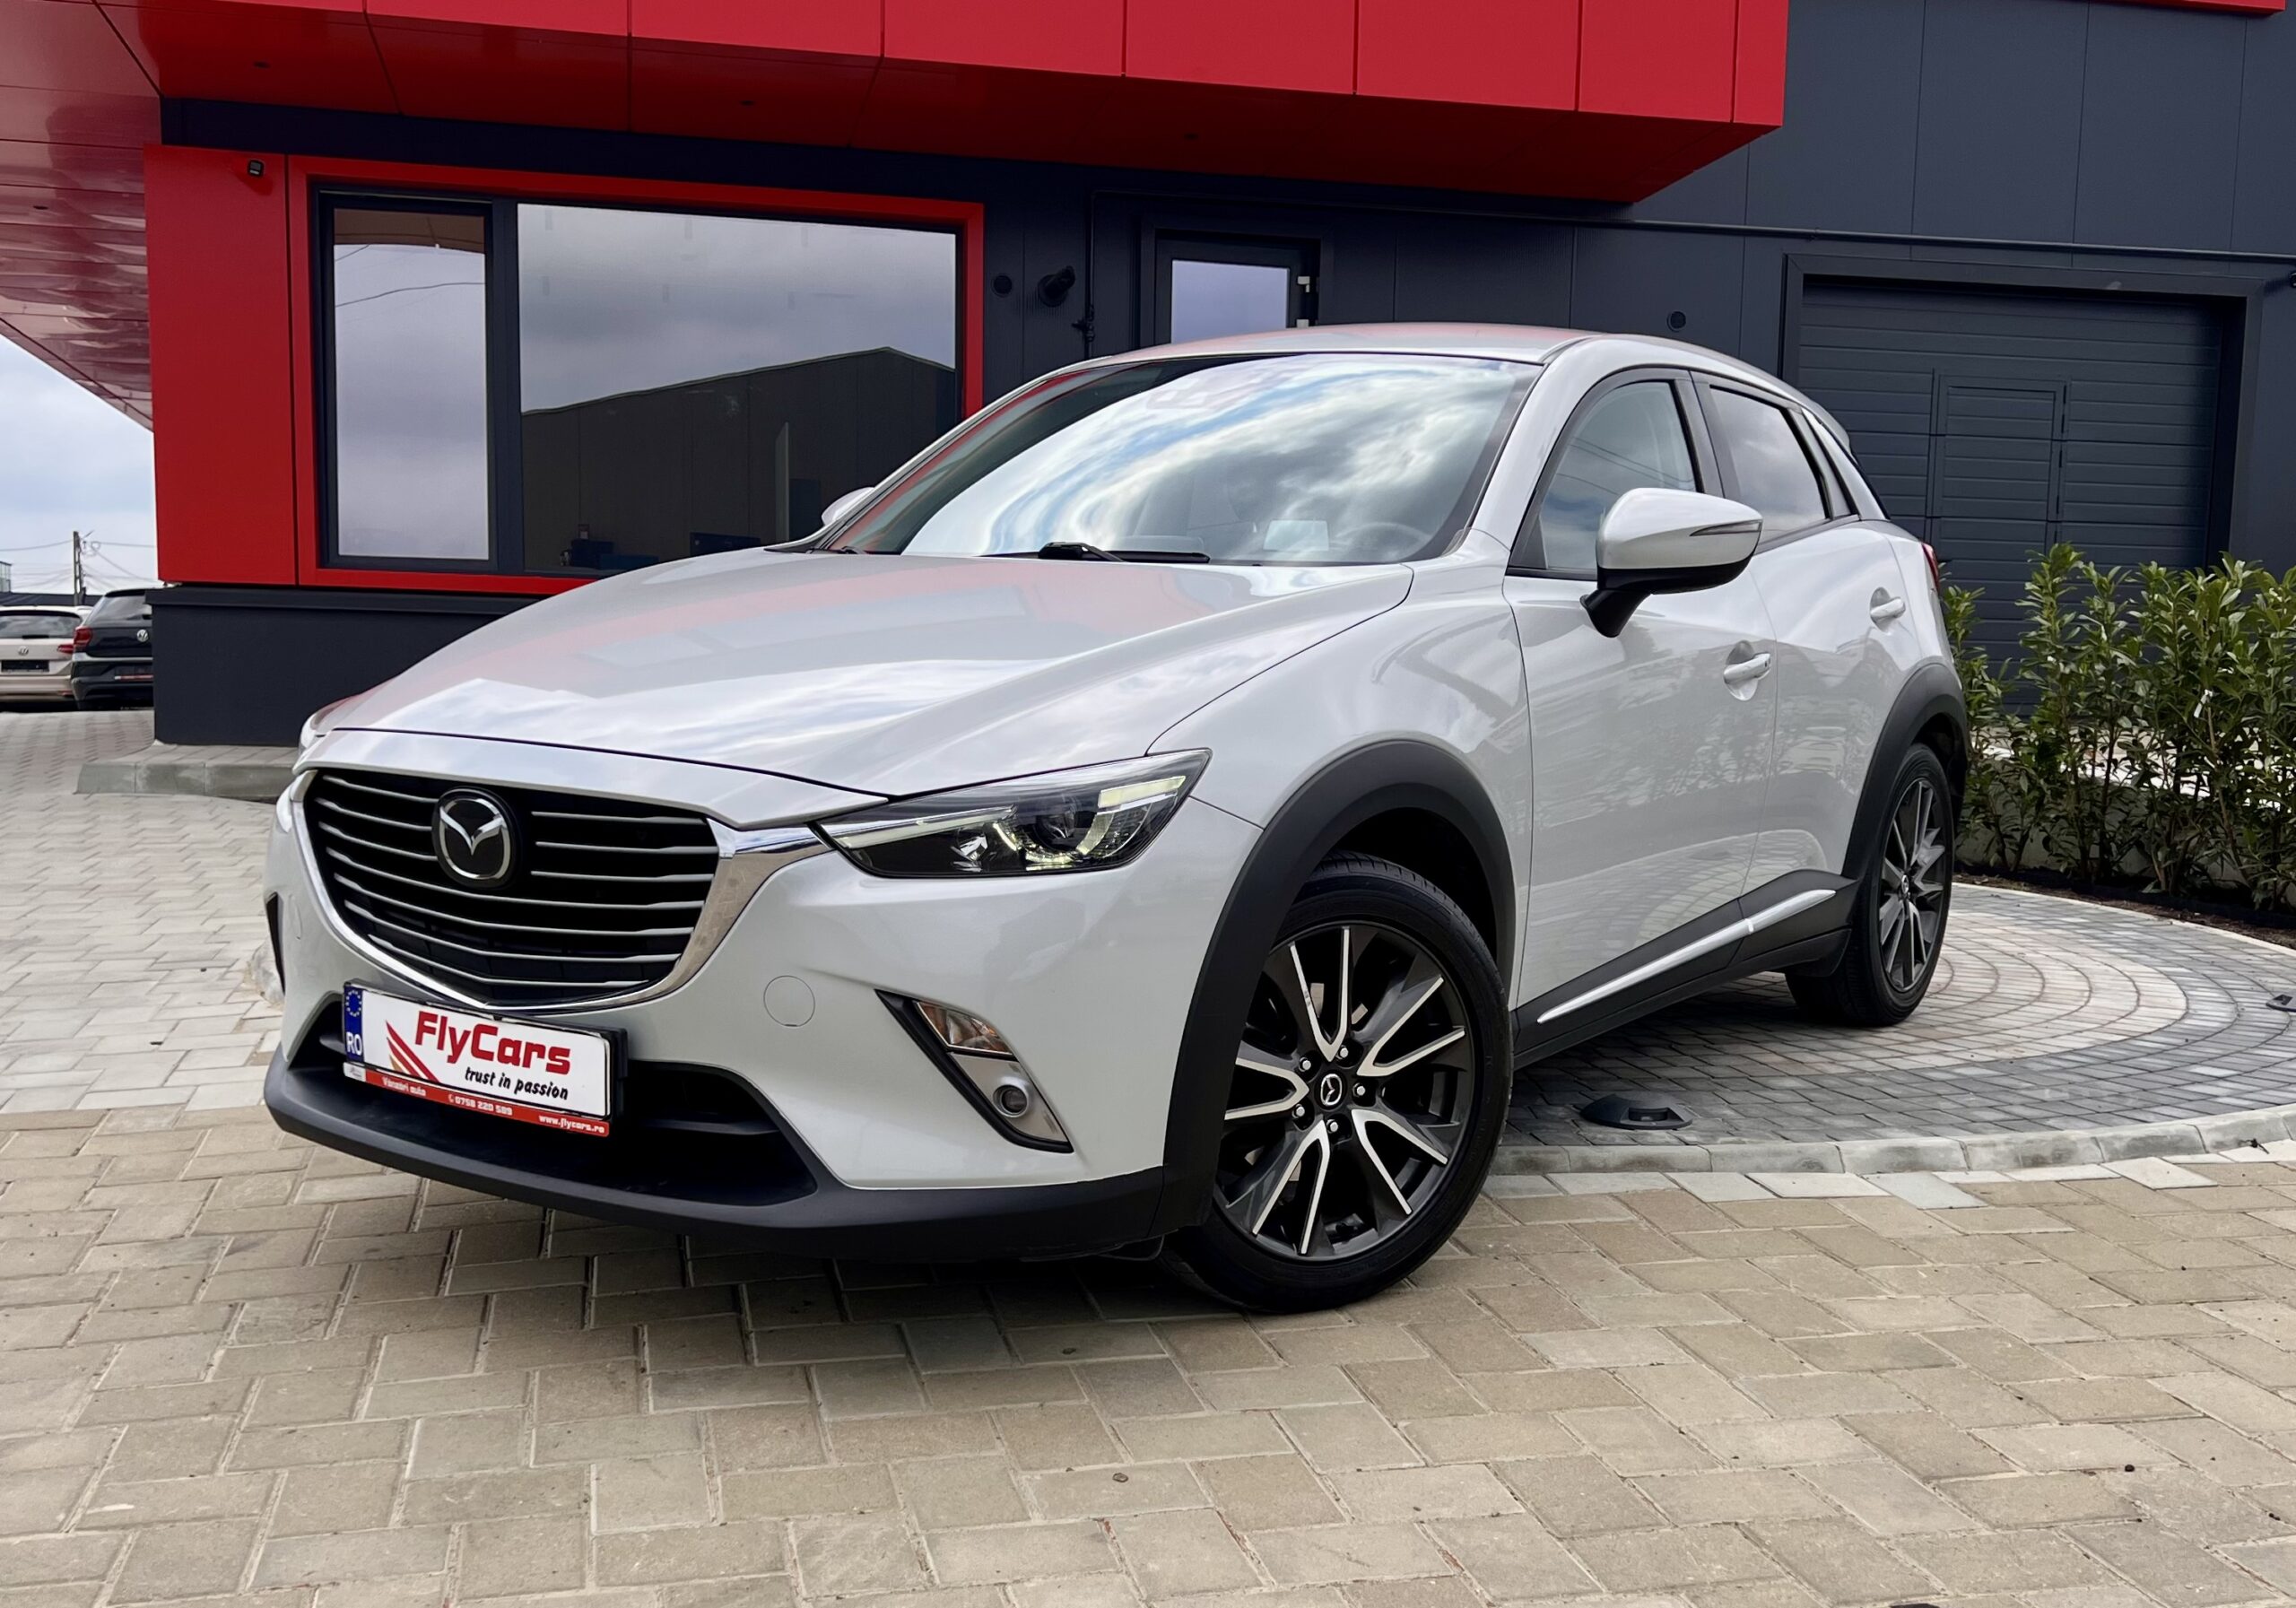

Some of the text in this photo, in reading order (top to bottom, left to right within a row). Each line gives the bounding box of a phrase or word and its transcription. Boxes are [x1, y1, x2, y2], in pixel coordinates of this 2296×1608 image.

[346, 1031, 362, 1056] RO
[415, 1011, 570, 1074] FlyCars
[465, 1067, 569, 1100] trust in passion
